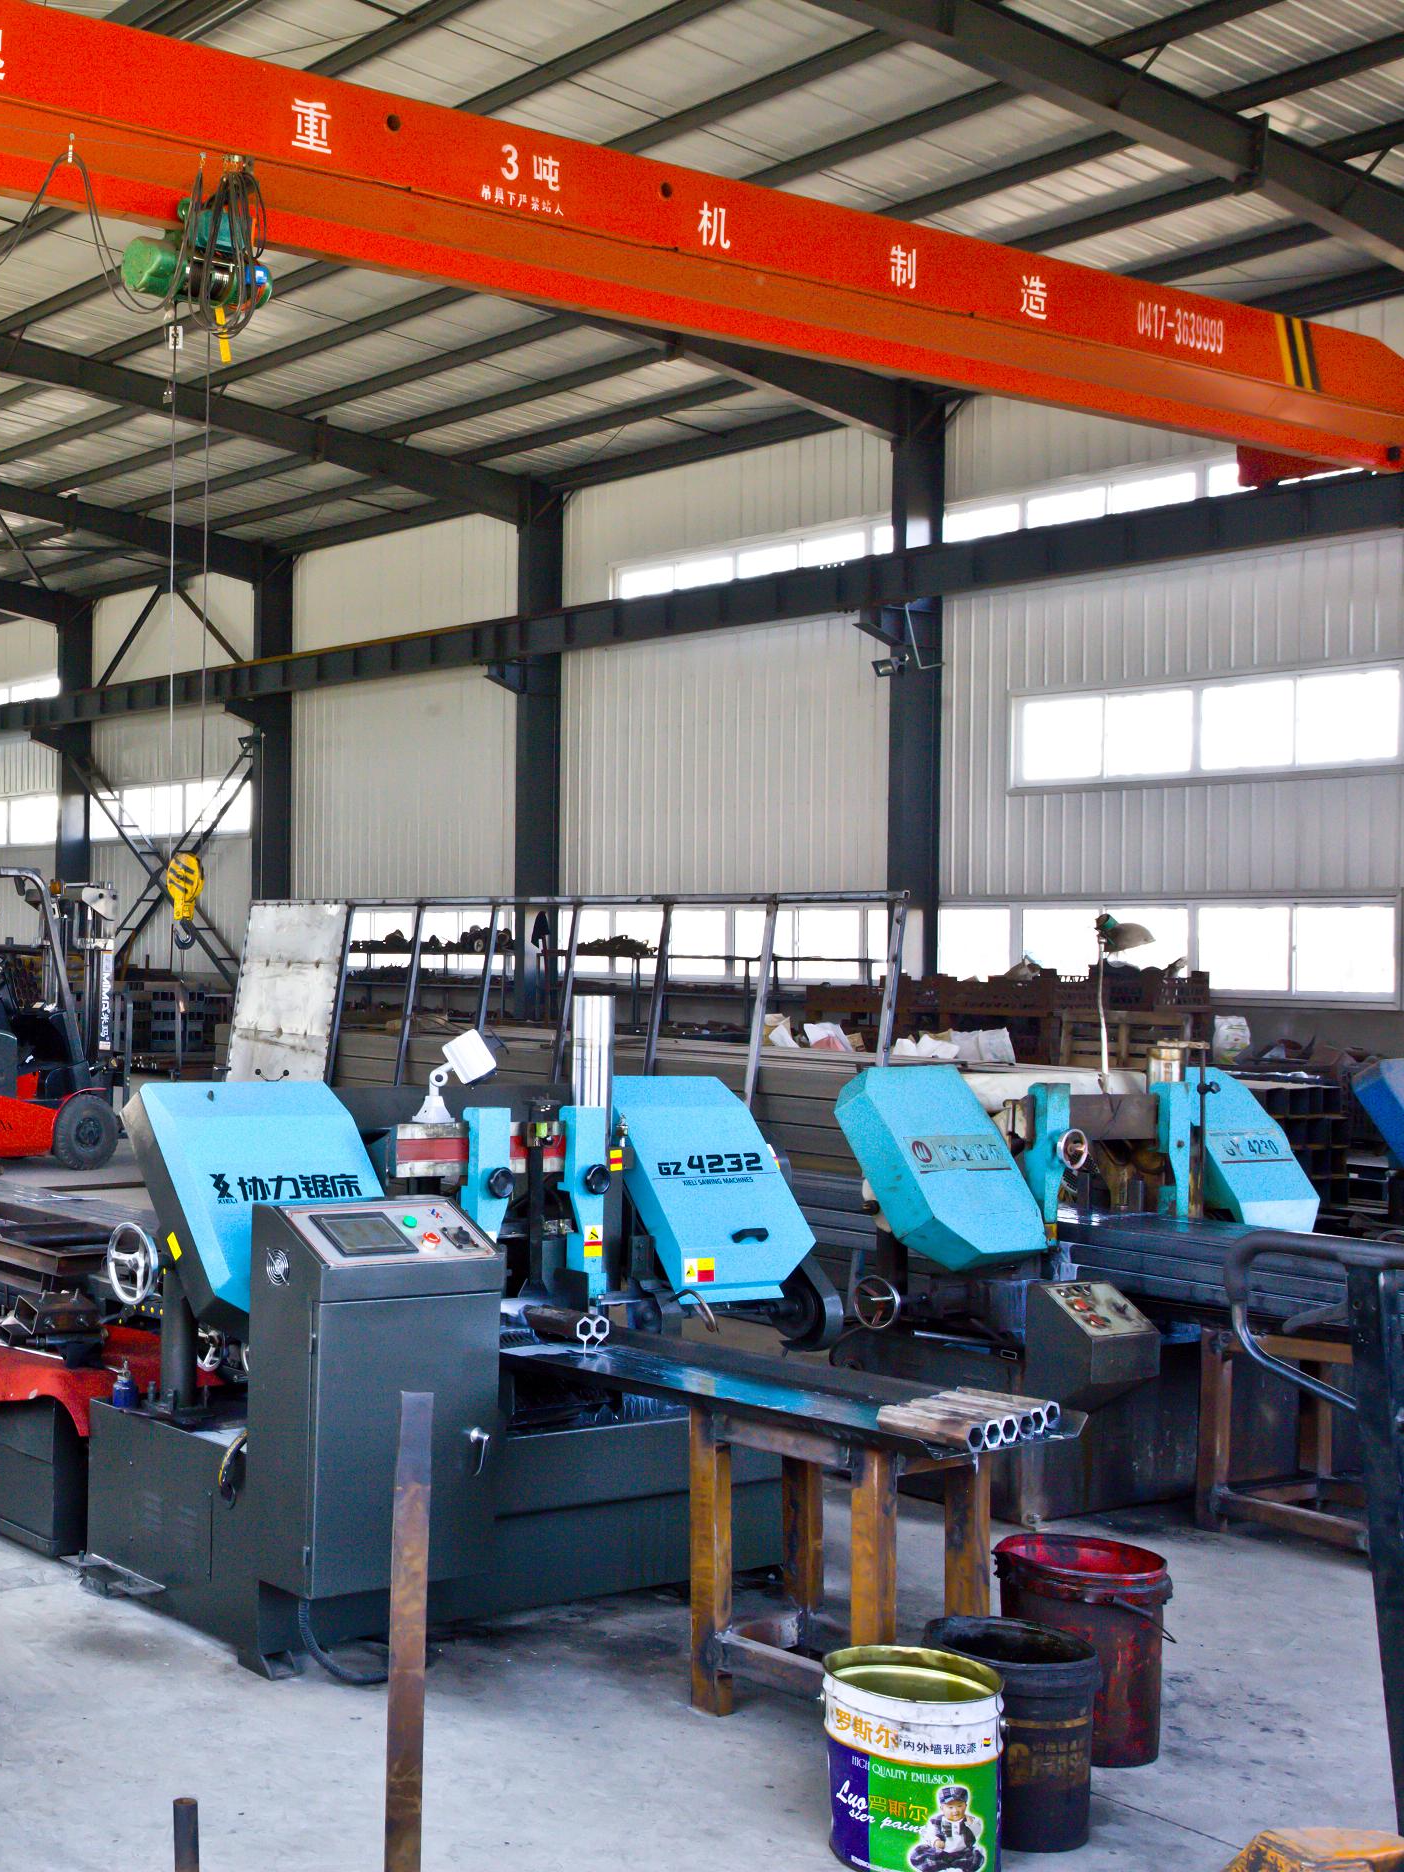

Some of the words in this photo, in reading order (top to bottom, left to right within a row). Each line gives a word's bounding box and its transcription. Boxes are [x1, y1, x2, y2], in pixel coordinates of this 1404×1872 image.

[291, 98, 332, 154] 重
[698, 201, 731, 249] 机
[890, 245, 917, 289] 制
[1020, 275, 1047, 320] 造
[1137, 301, 1223, 354] 0417-3639999
[657, 1161, 685, 1175] GZ
[687, 1152, 763, 1173] 4232
[237, 1173, 362, 1201] 协力锯床
[851, 1755, 870, 1771] HIGH
[872, 1763, 908, 1783] QUALITY
[911, 1772, 955, 1785] EMULSION
[836, 1779, 868, 1809] Luo
[848, 1808, 876, 1824] sier
